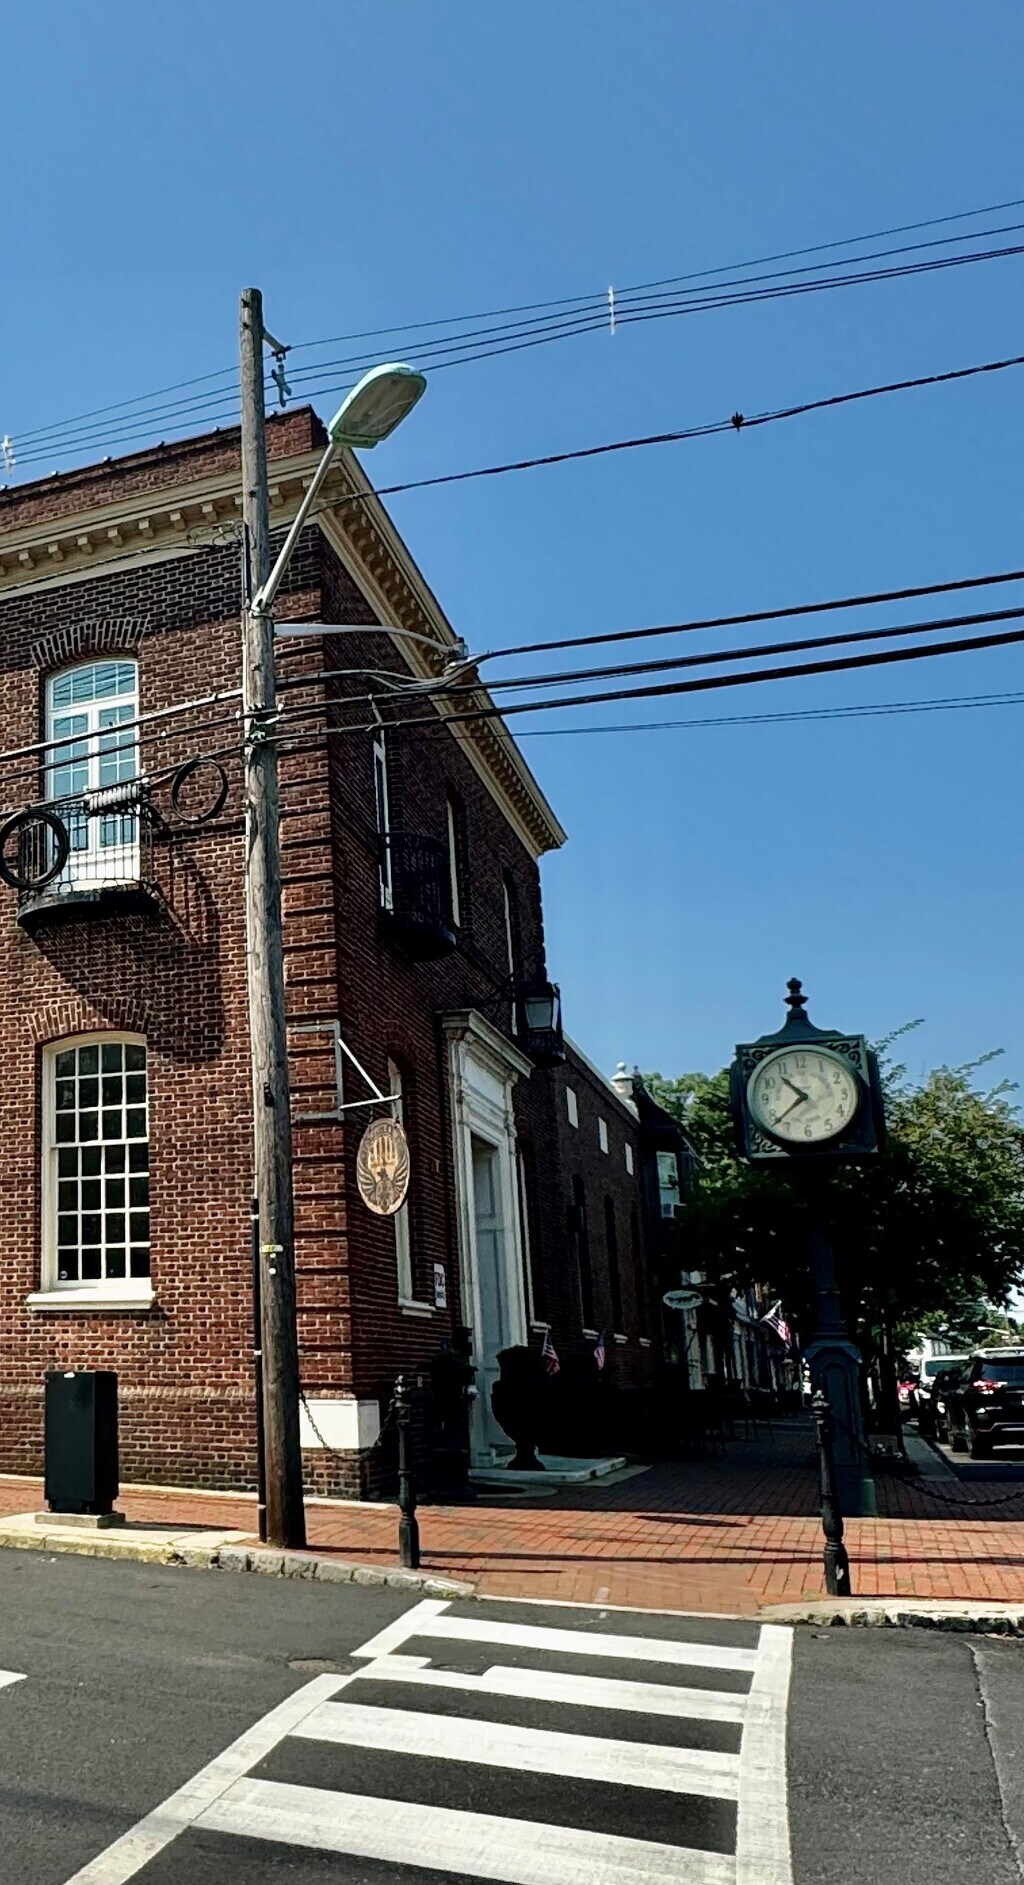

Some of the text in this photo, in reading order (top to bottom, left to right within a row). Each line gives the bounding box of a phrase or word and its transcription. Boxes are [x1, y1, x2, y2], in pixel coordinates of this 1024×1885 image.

[777, 1062, 787, 1075] 11
[794, 1056, 807, 1069] 12
[763, 1077, 775, 1089] 10
[833, 1072, 841, 1084] 2
[762, 1093, 769, 1105] 9
[841, 1088, 848, 1101] 3
[768, 1109, 776, 1121] 8
[837, 1104, 845, 1117] 4
[783, 1122, 791, 1133] 7
[824, 1118, 833, 1131] 5
[804, 1125, 812, 1137] 6
